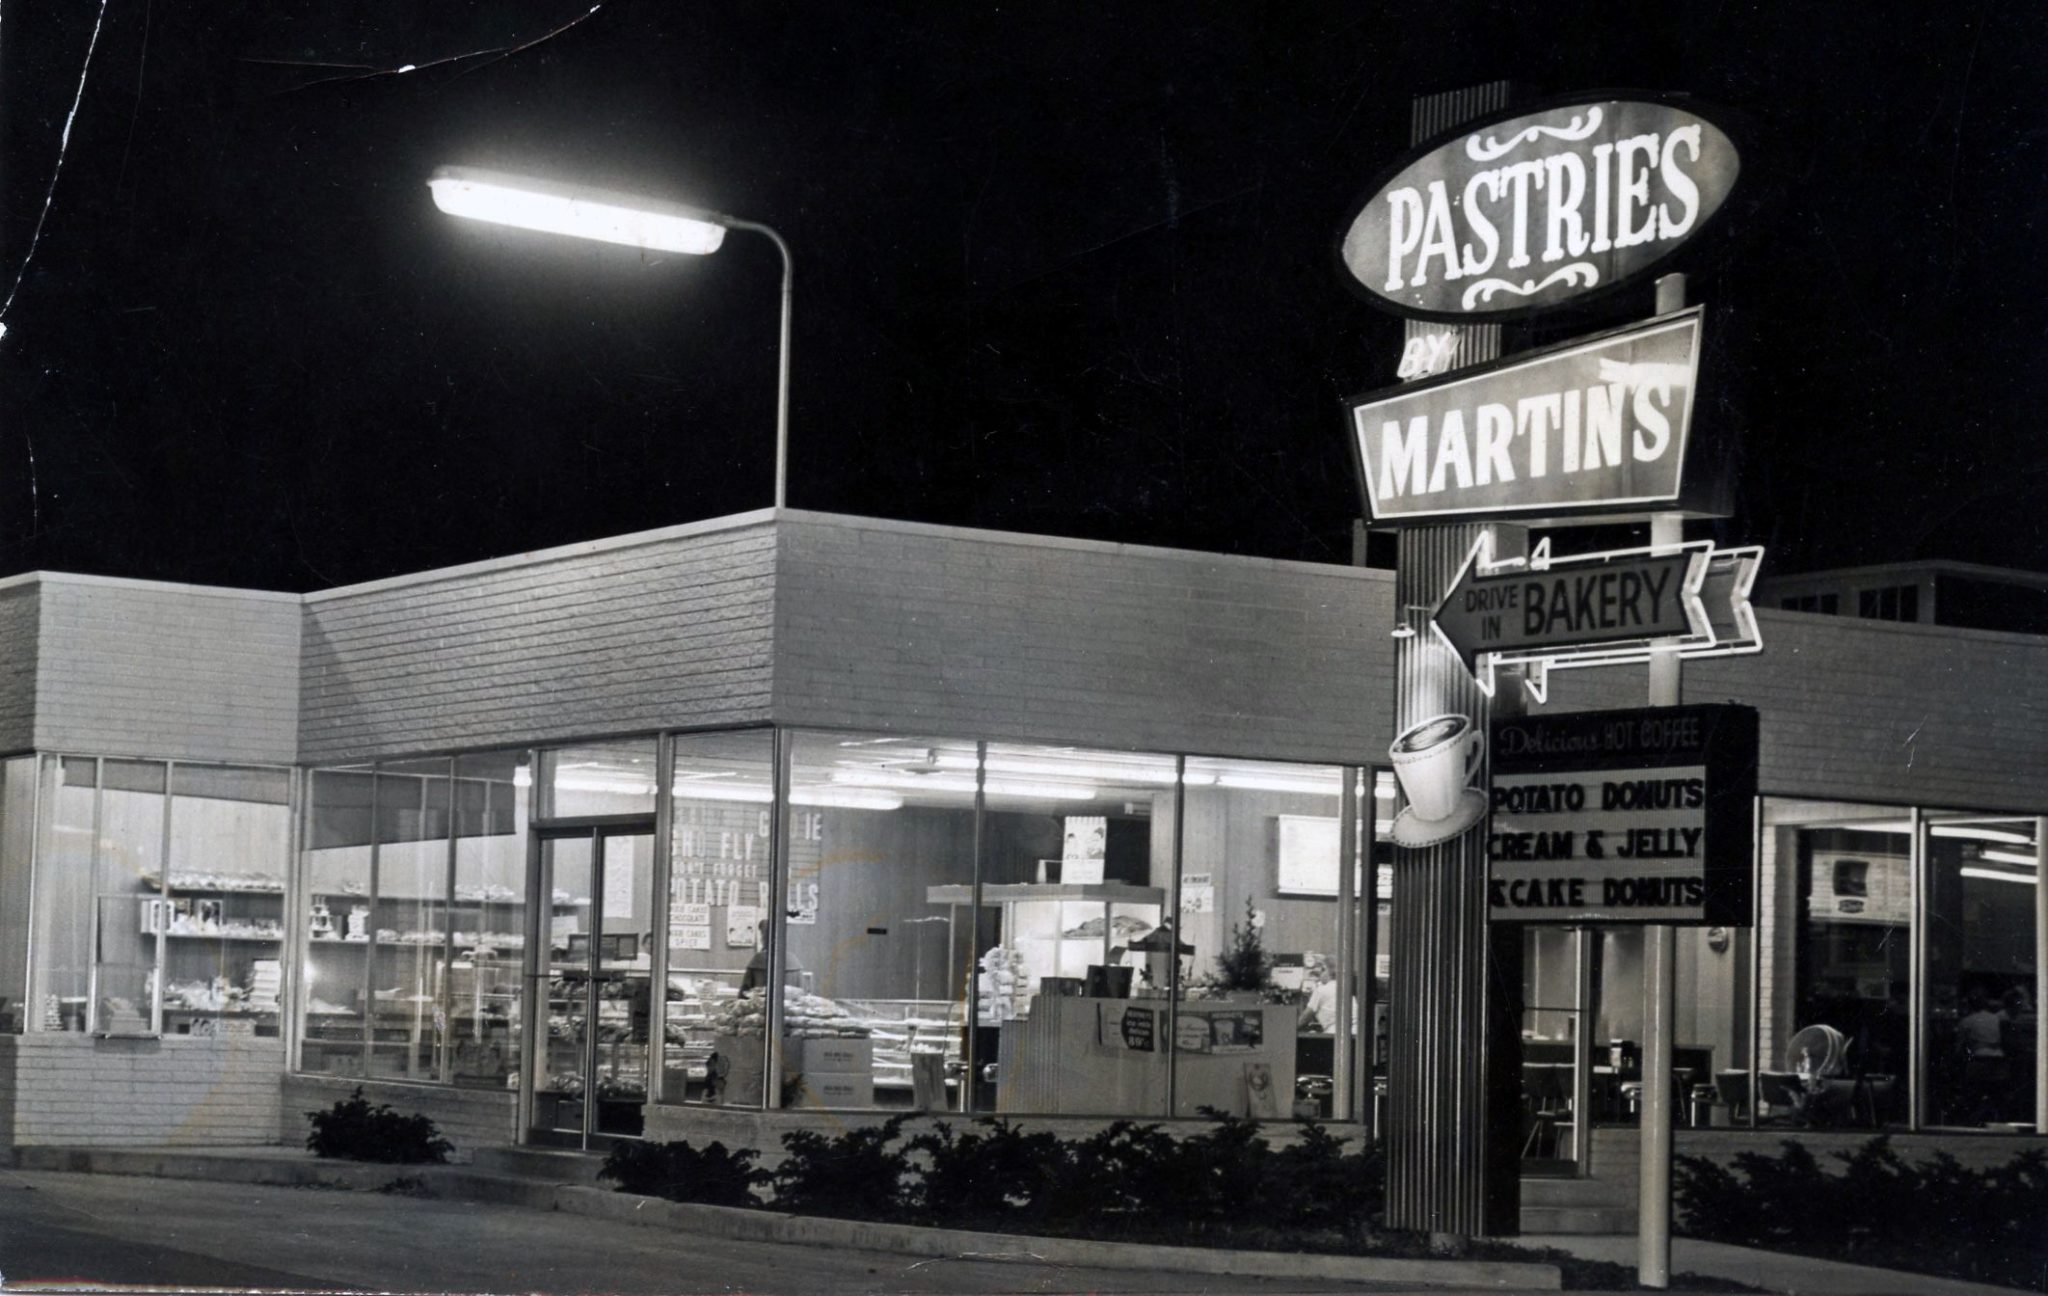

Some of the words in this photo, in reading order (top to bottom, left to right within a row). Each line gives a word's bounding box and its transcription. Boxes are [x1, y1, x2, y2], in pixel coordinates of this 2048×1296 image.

[1384, 123, 1701, 291] PASTRIES
[1397, 333, 1453, 378] BY
[1465, 583, 1518, 614] DRIVE
[1523, 566, 1671, 637] BAKERY
[1481, 616, 1501, 642] IN
[1500, 722, 1598, 755] Delicious
[1603, 721, 1635, 750] HOT
[1640, 716, 1700, 749] COFFEE
[1489, 783, 1585, 814] POTATO
[1602, 778, 1706, 811] DONUTS
[1487, 830, 1573, 860] CREAM
[1617, 827, 1703, 858] JELLY
[1603, 875, 1705, 908] DONUTS
